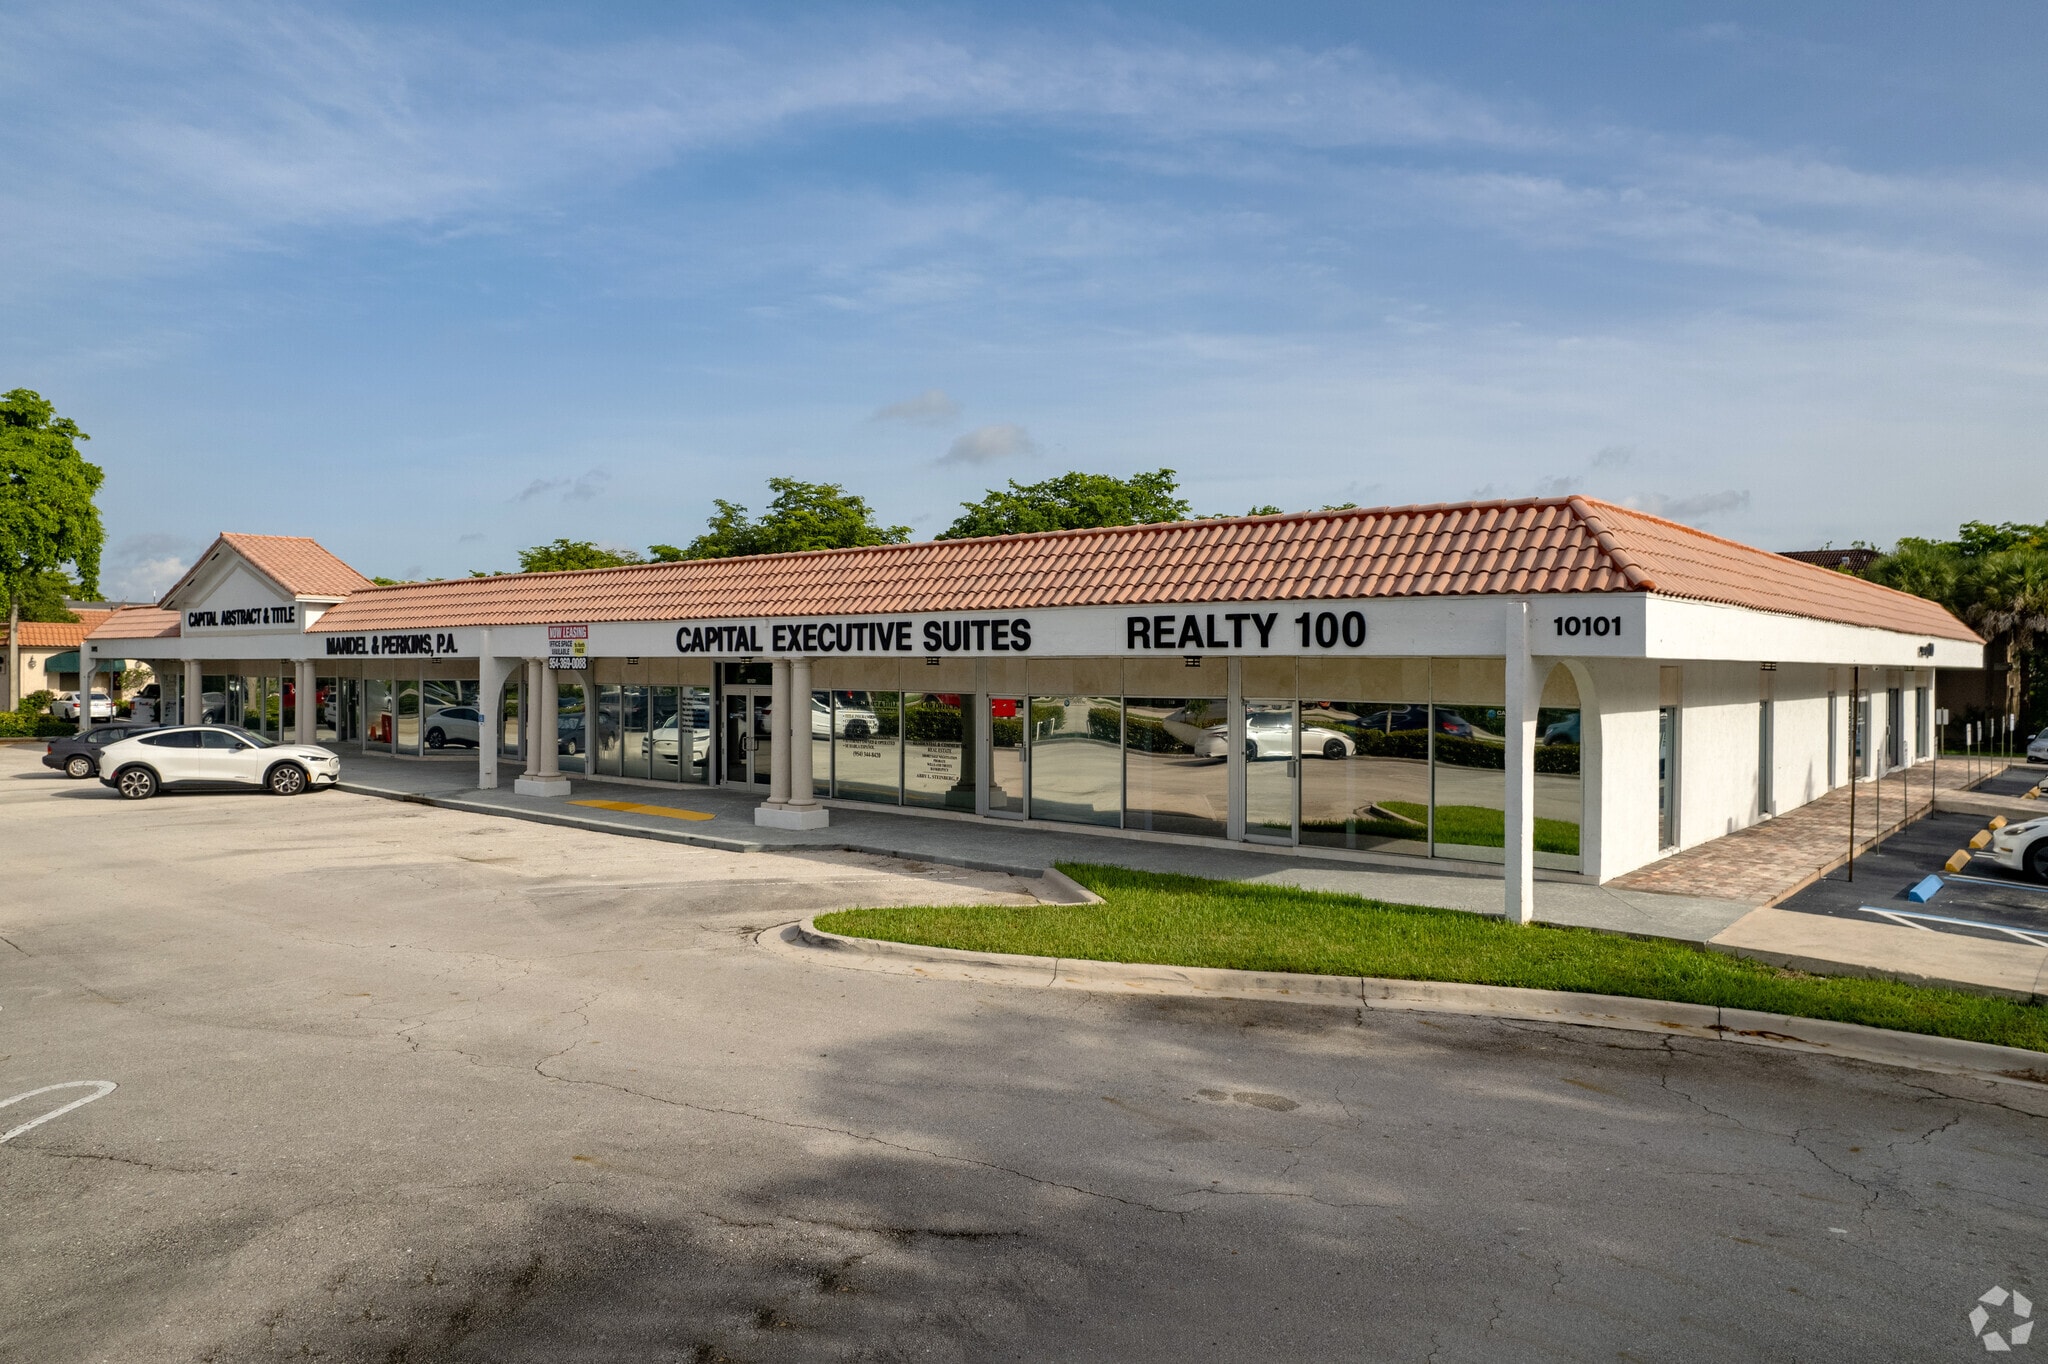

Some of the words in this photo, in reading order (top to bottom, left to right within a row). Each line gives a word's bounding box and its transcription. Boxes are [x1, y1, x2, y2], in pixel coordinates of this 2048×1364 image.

[188, 612, 218, 628] CAPITAL
[220, 608, 262, 626] ABSTRACT
[263, 608, 270, 624] &
[271, 606, 295, 624] TITLE
[1553, 615, 1622, 638] 10101
[549, 627, 562, 638] NOW
[563, 626, 587, 638] LEASING
[676, 625, 764, 653] CAPITAL
[772, 621, 913, 653] EXECUTIVE
[923, 618, 1032, 653] SUITES
[1126, 612, 1279, 650] REALTY
[1294, 610, 1367, 649] 100
[326, 637, 369, 655] MANDEL
[371, 635, 380, 655] &
[381, 633, 434, 657] PERKINS,
[436, 633, 458, 654] P.A.
